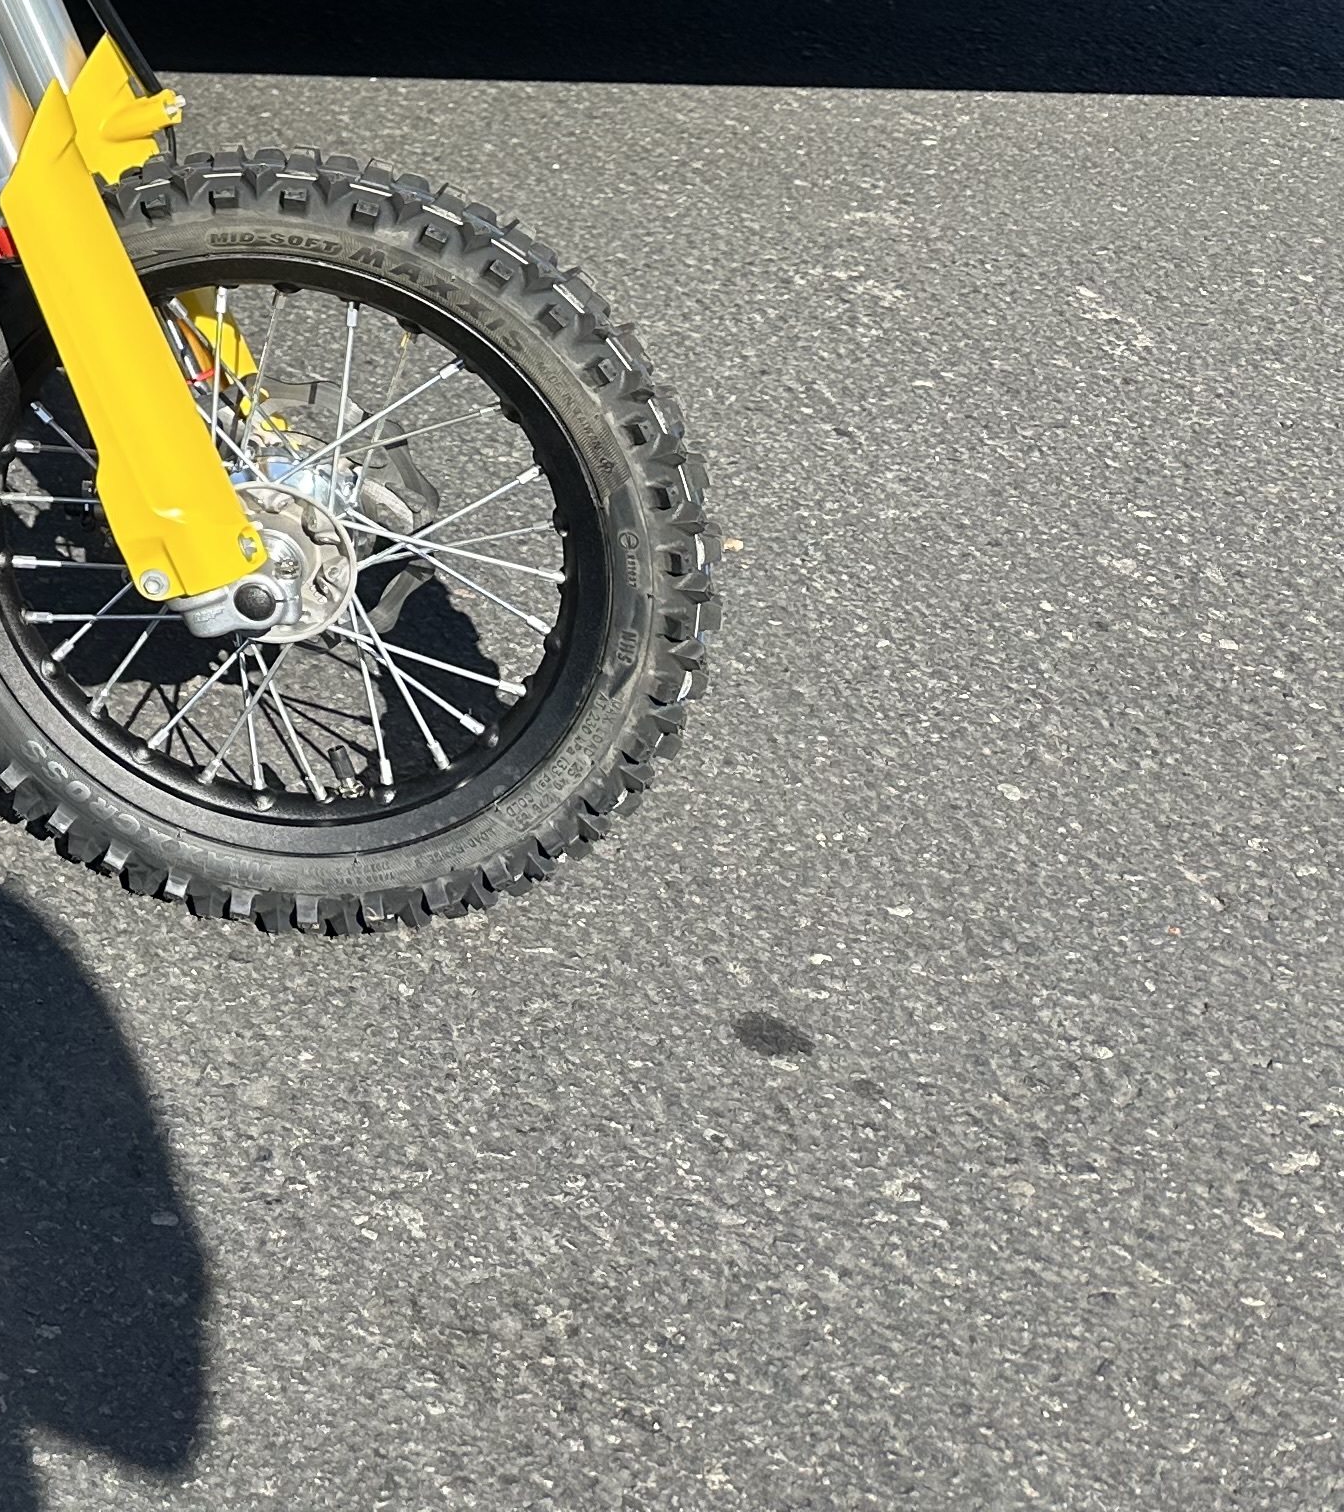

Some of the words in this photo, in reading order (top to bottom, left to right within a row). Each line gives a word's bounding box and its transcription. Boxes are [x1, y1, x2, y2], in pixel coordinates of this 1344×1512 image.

[209, 231, 342, 253] MID-SOFT
[348, 246, 525, 352] MAXXIS
[616, 629, 638, 665] NHS
[592, 691, 611, 709] AT
[578, 710, 603, 736] 230
[563, 734, 588, 759] kPa
[579, 726, 610, 759] LOAD
[548, 755, 572, 777] (33
[503, 790, 536, 819] COLD
